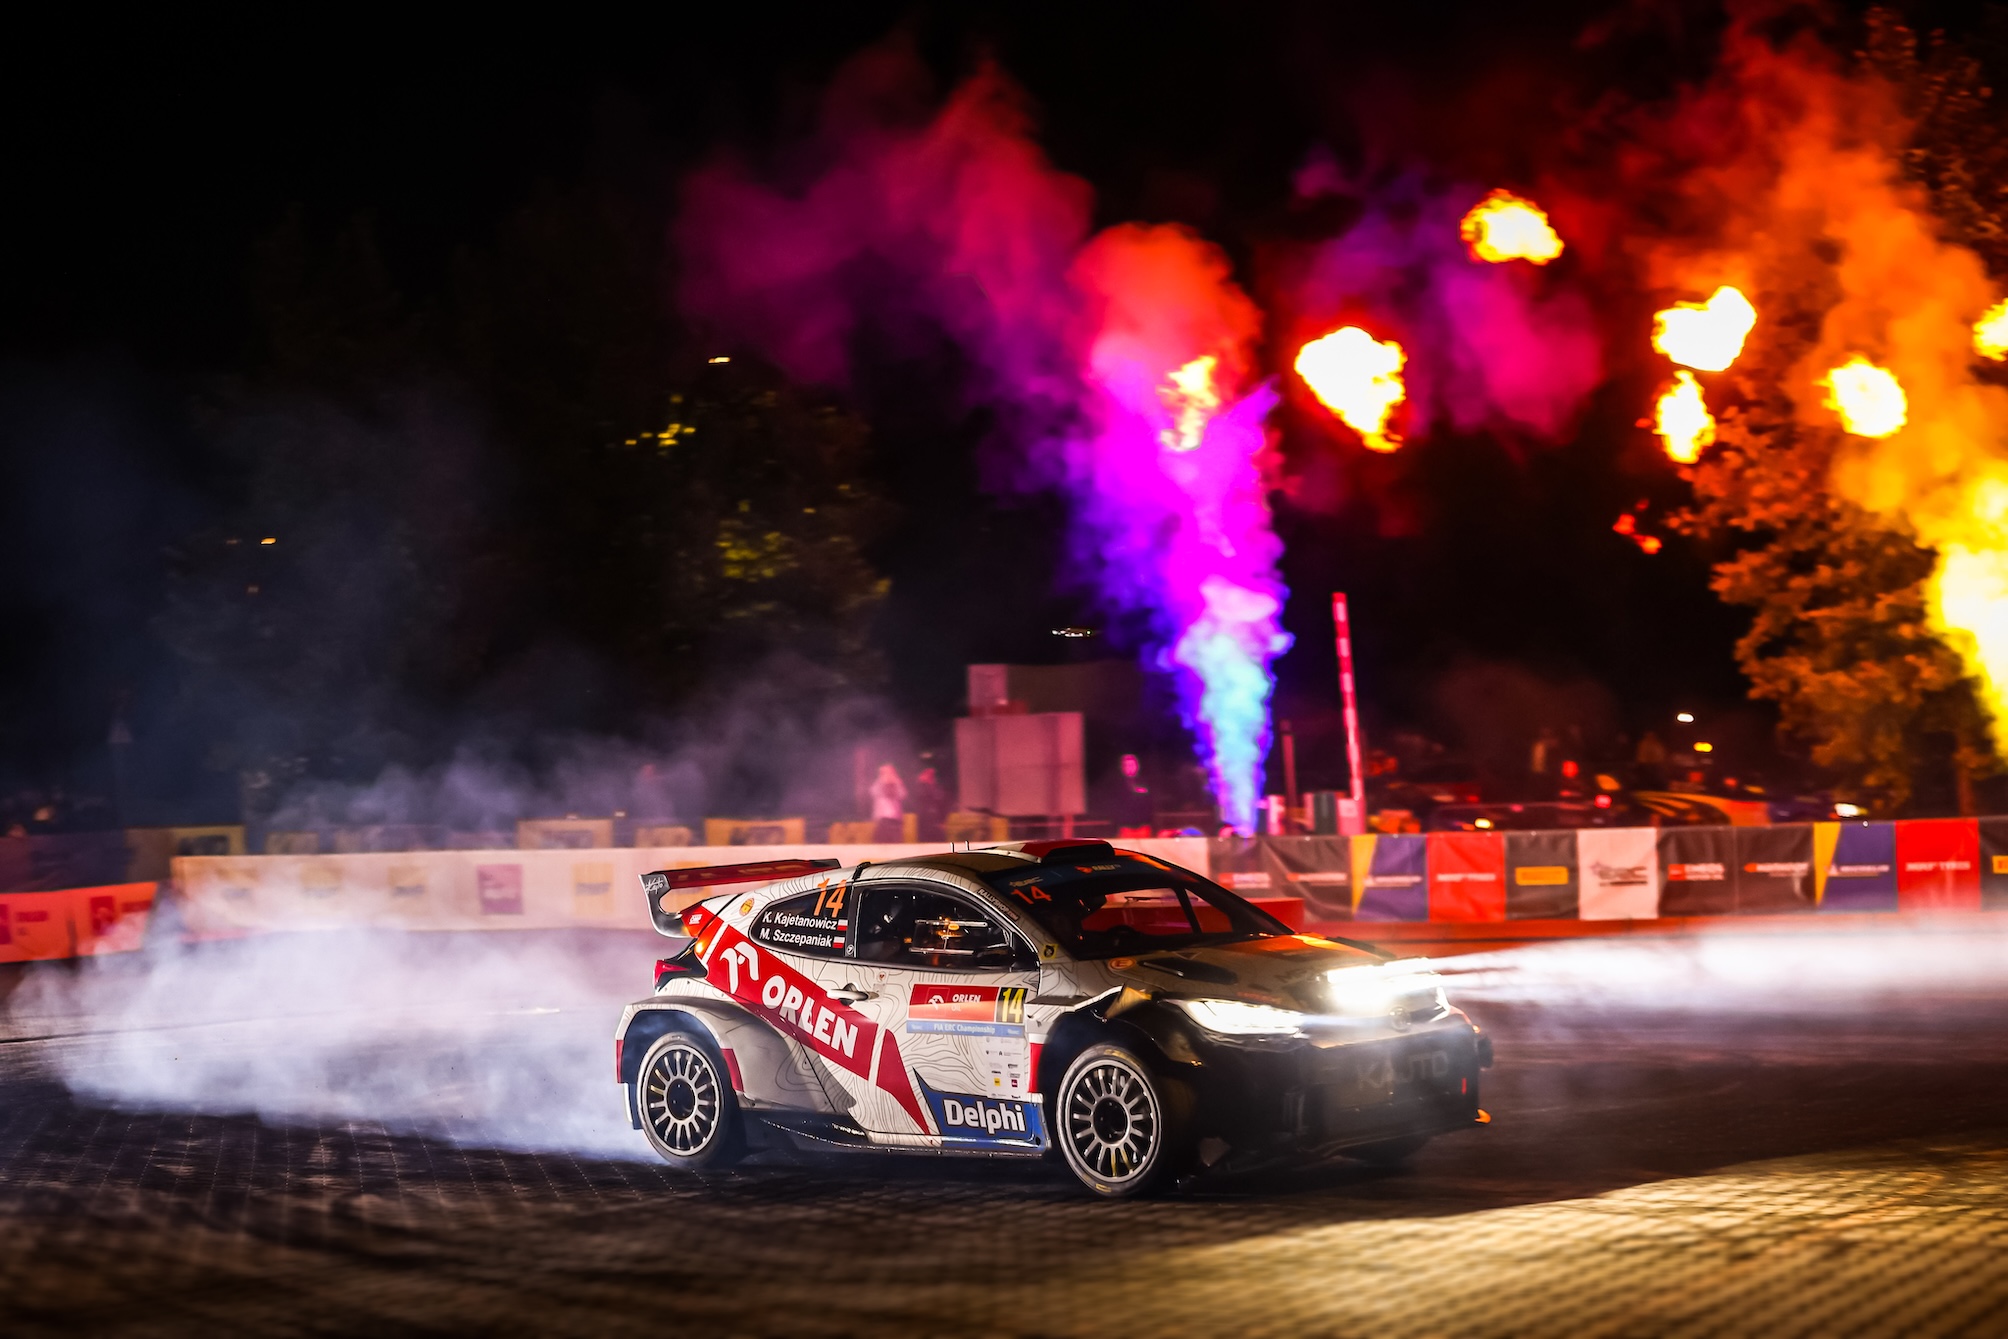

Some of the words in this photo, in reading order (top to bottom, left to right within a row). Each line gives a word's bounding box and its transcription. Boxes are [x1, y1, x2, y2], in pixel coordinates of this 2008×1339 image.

[814, 878, 847, 918] 14
[1011, 885, 1052, 905] 14
[762, 911, 773, 923] K.
[774, 912, 838, 930] Kajetanowicz
[759, 928, 771, 940] M.
[773, 930, 832, 948] Szczepaniak
[952, 994, 981, 1003] ORLEN
[1002, 987, 1025, 1023] 14
[762, 975, 858, 1059] ORLEN
[933, 1023, 945, 1032] FIA
[956, 1024, 996, 1035] Championship
[943, 1099, 1026, 1135] Delphi
